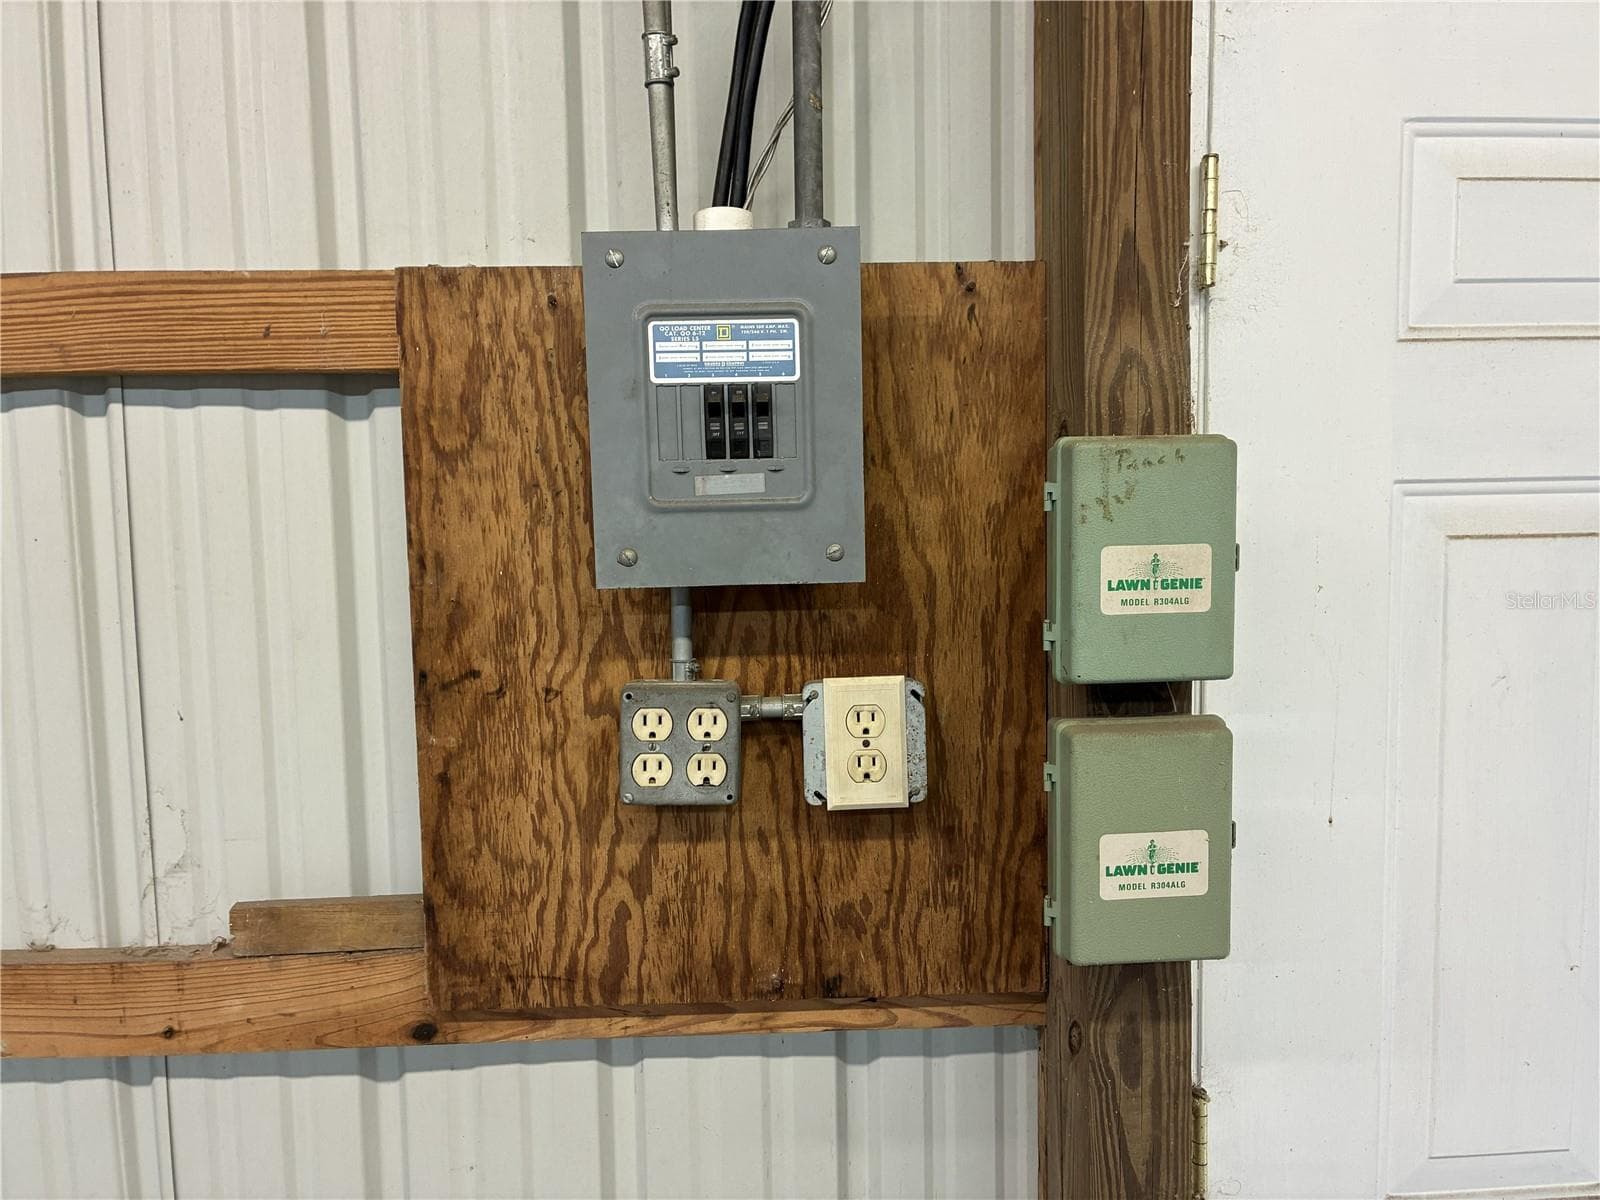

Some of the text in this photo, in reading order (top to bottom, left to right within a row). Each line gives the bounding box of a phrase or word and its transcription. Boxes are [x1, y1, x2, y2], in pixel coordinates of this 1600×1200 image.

[1107, 577, 1203, 592] LAWN GENIE
[1120, 597, 1190, 607] MODEL R304ALG
[1105, 862, 1199, 877] LAWN GENIE
[1118, 881, 1186, 891] MODEL R304ALG
